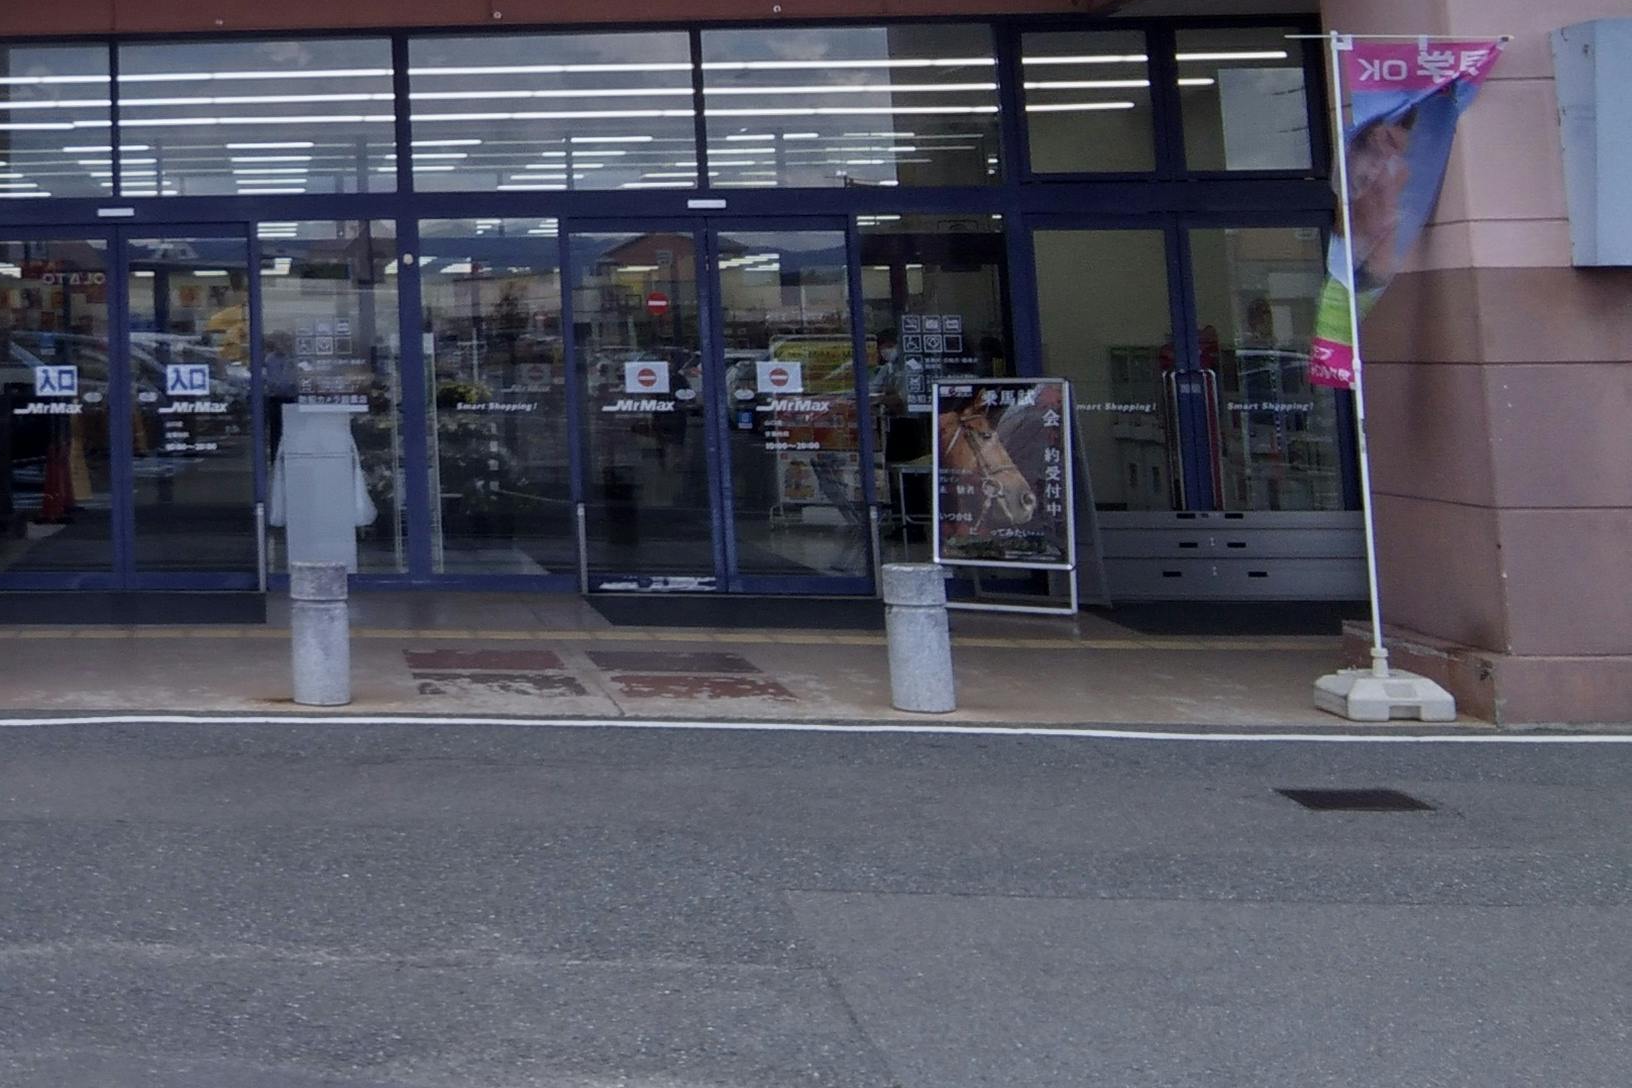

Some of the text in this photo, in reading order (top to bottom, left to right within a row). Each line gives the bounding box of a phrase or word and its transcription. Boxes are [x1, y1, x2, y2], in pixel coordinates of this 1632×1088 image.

[39, 368, 76, 392] 入口
[170, 367, 206, 391] 入口
[13, 402, 83, 414] MrMax
[158, 401, 228, 414] MrMax
[456, 402, 486, 410] Smart
[601, 399, 676, 412] MrMax
[755, 399, 831, 412] MrMax
[1227, 402, 1258, 410] Smart
